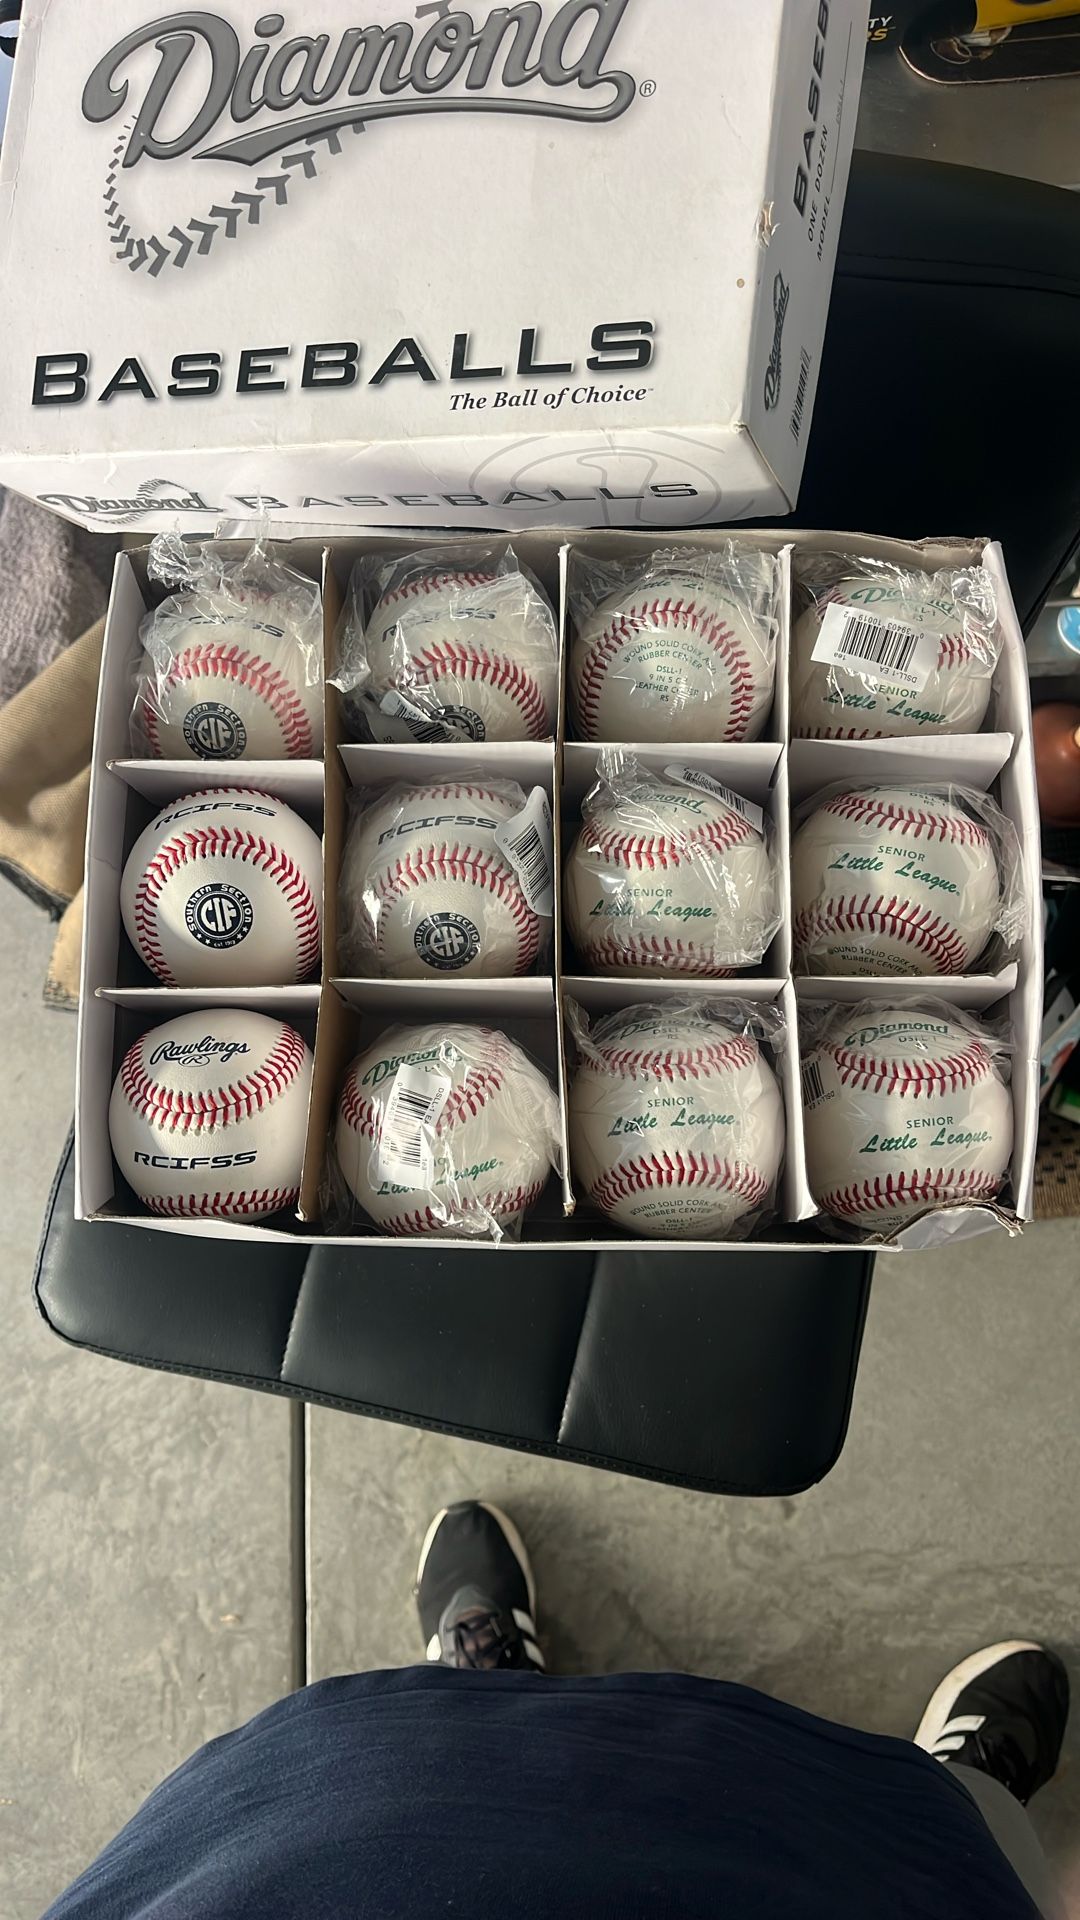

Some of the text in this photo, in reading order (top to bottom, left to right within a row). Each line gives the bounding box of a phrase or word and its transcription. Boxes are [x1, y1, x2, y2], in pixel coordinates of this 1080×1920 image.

[82, 0, 637, 168] Diamond
[808, 125, 828, 242] ONE DOZEN
[817, 196, 830, 261] MODEL
[32, 321, 655, 406] BASEBALLS
[449, 384, 648, 411] The Ball of Choice
[36, 490, 224, 517] Diamond
[232, 483, 698, 510] BASEBALLS
[857, 613, 882, 626] 10019
[887, 622, 912, 636] 39403
[623, 641, 653, 664] WOUND
[655, 639, 679, 648] SOLID
[637, 650, 670, 664] RUBBER
[656, 665, 682, 675] DSLL-1
[656, 674, 666, 682] IN
[879, 665, 918, 684] DSLL-1 EA
[823, 687, 947, 726] Little League
[197, 717, 233, 750] CIF
[217, 704, 245, 745] Section
[154, 803, 278, 831] RCIFSS
[378, 815, 499, 846] RCIFSS
[876, 844, 927, 862] SENIOR
[828, 852, 958, 894] Little League
[626, 887, 674, 898] SENIOR
[185, 884, 252, 932] Southern Section
[201, 897, 238, 933] CIF
[646, 900, 713, 922] League
[844, 1022, 949, 1047] Diamond
[150, 1036, 251, 1065] Rawlings
[428, 1087, 445, 1114] DSLL-1
[647, 1096, 695, 1108] SENIOR
[670, 1108, 736, 1130] League
[906, 1116, 954, 1129] SENIOR
[858, 1127, 988, 1153] Little League
[134, 1150, 258, 1170] RCIFSS
